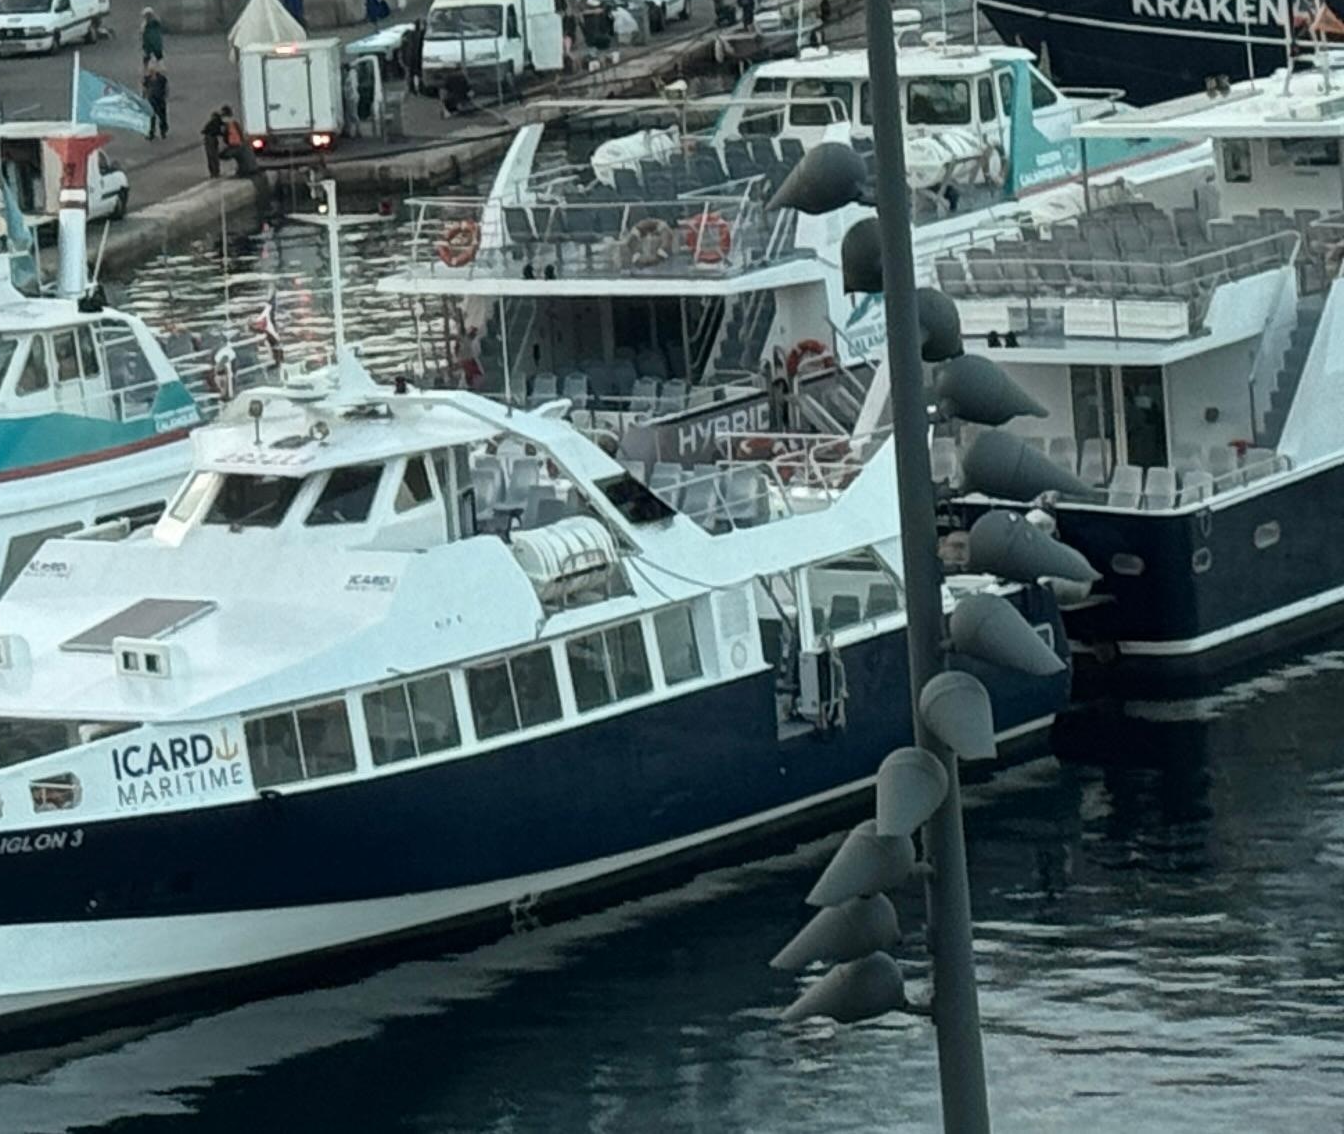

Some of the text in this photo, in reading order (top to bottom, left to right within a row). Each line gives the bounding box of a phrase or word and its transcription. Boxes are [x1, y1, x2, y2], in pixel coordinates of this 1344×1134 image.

[112, 733, 214, 781] ICARD
[116, 762, 244, 807] MARITIME
[70, 828, 84, 847] 3
